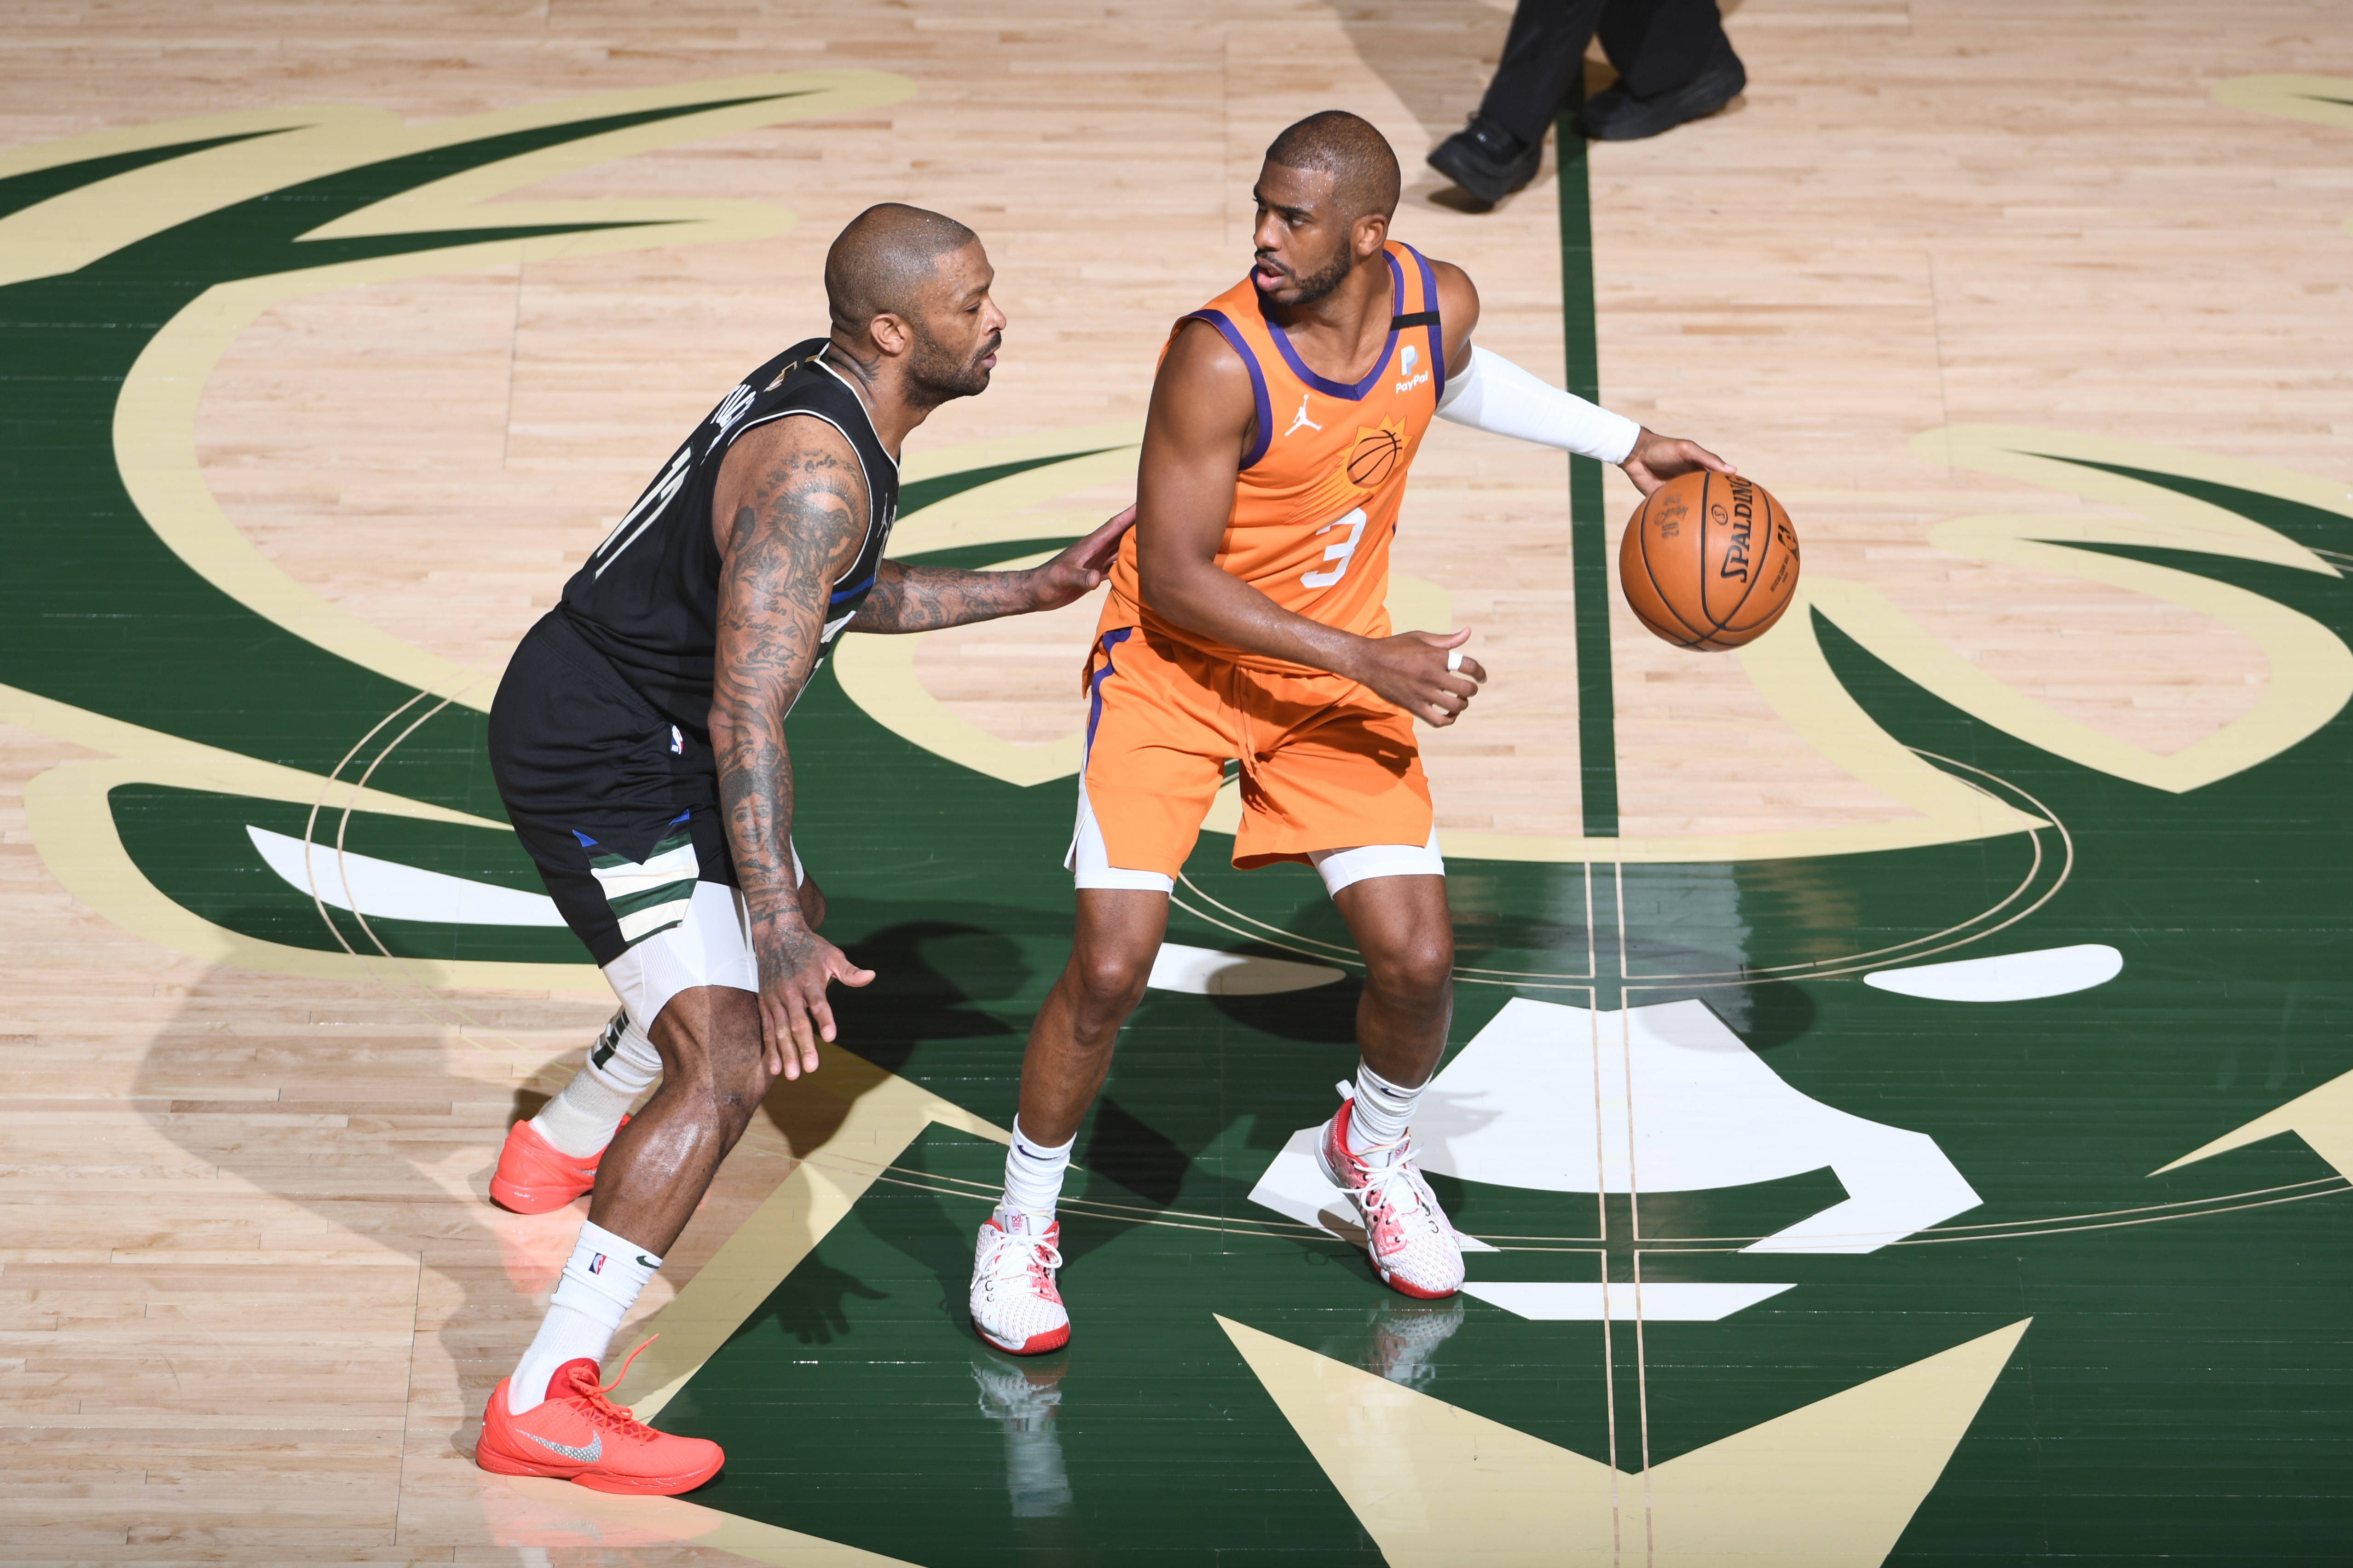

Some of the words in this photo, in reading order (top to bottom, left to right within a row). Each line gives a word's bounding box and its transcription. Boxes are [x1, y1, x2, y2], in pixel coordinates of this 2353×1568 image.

[1395, 370, 1428, 394] PayPal
[594, 443, 693, 582] 17
[1300, 507, 1367, 588] 3
[1720, 475, 1753, 583] SPALDING
